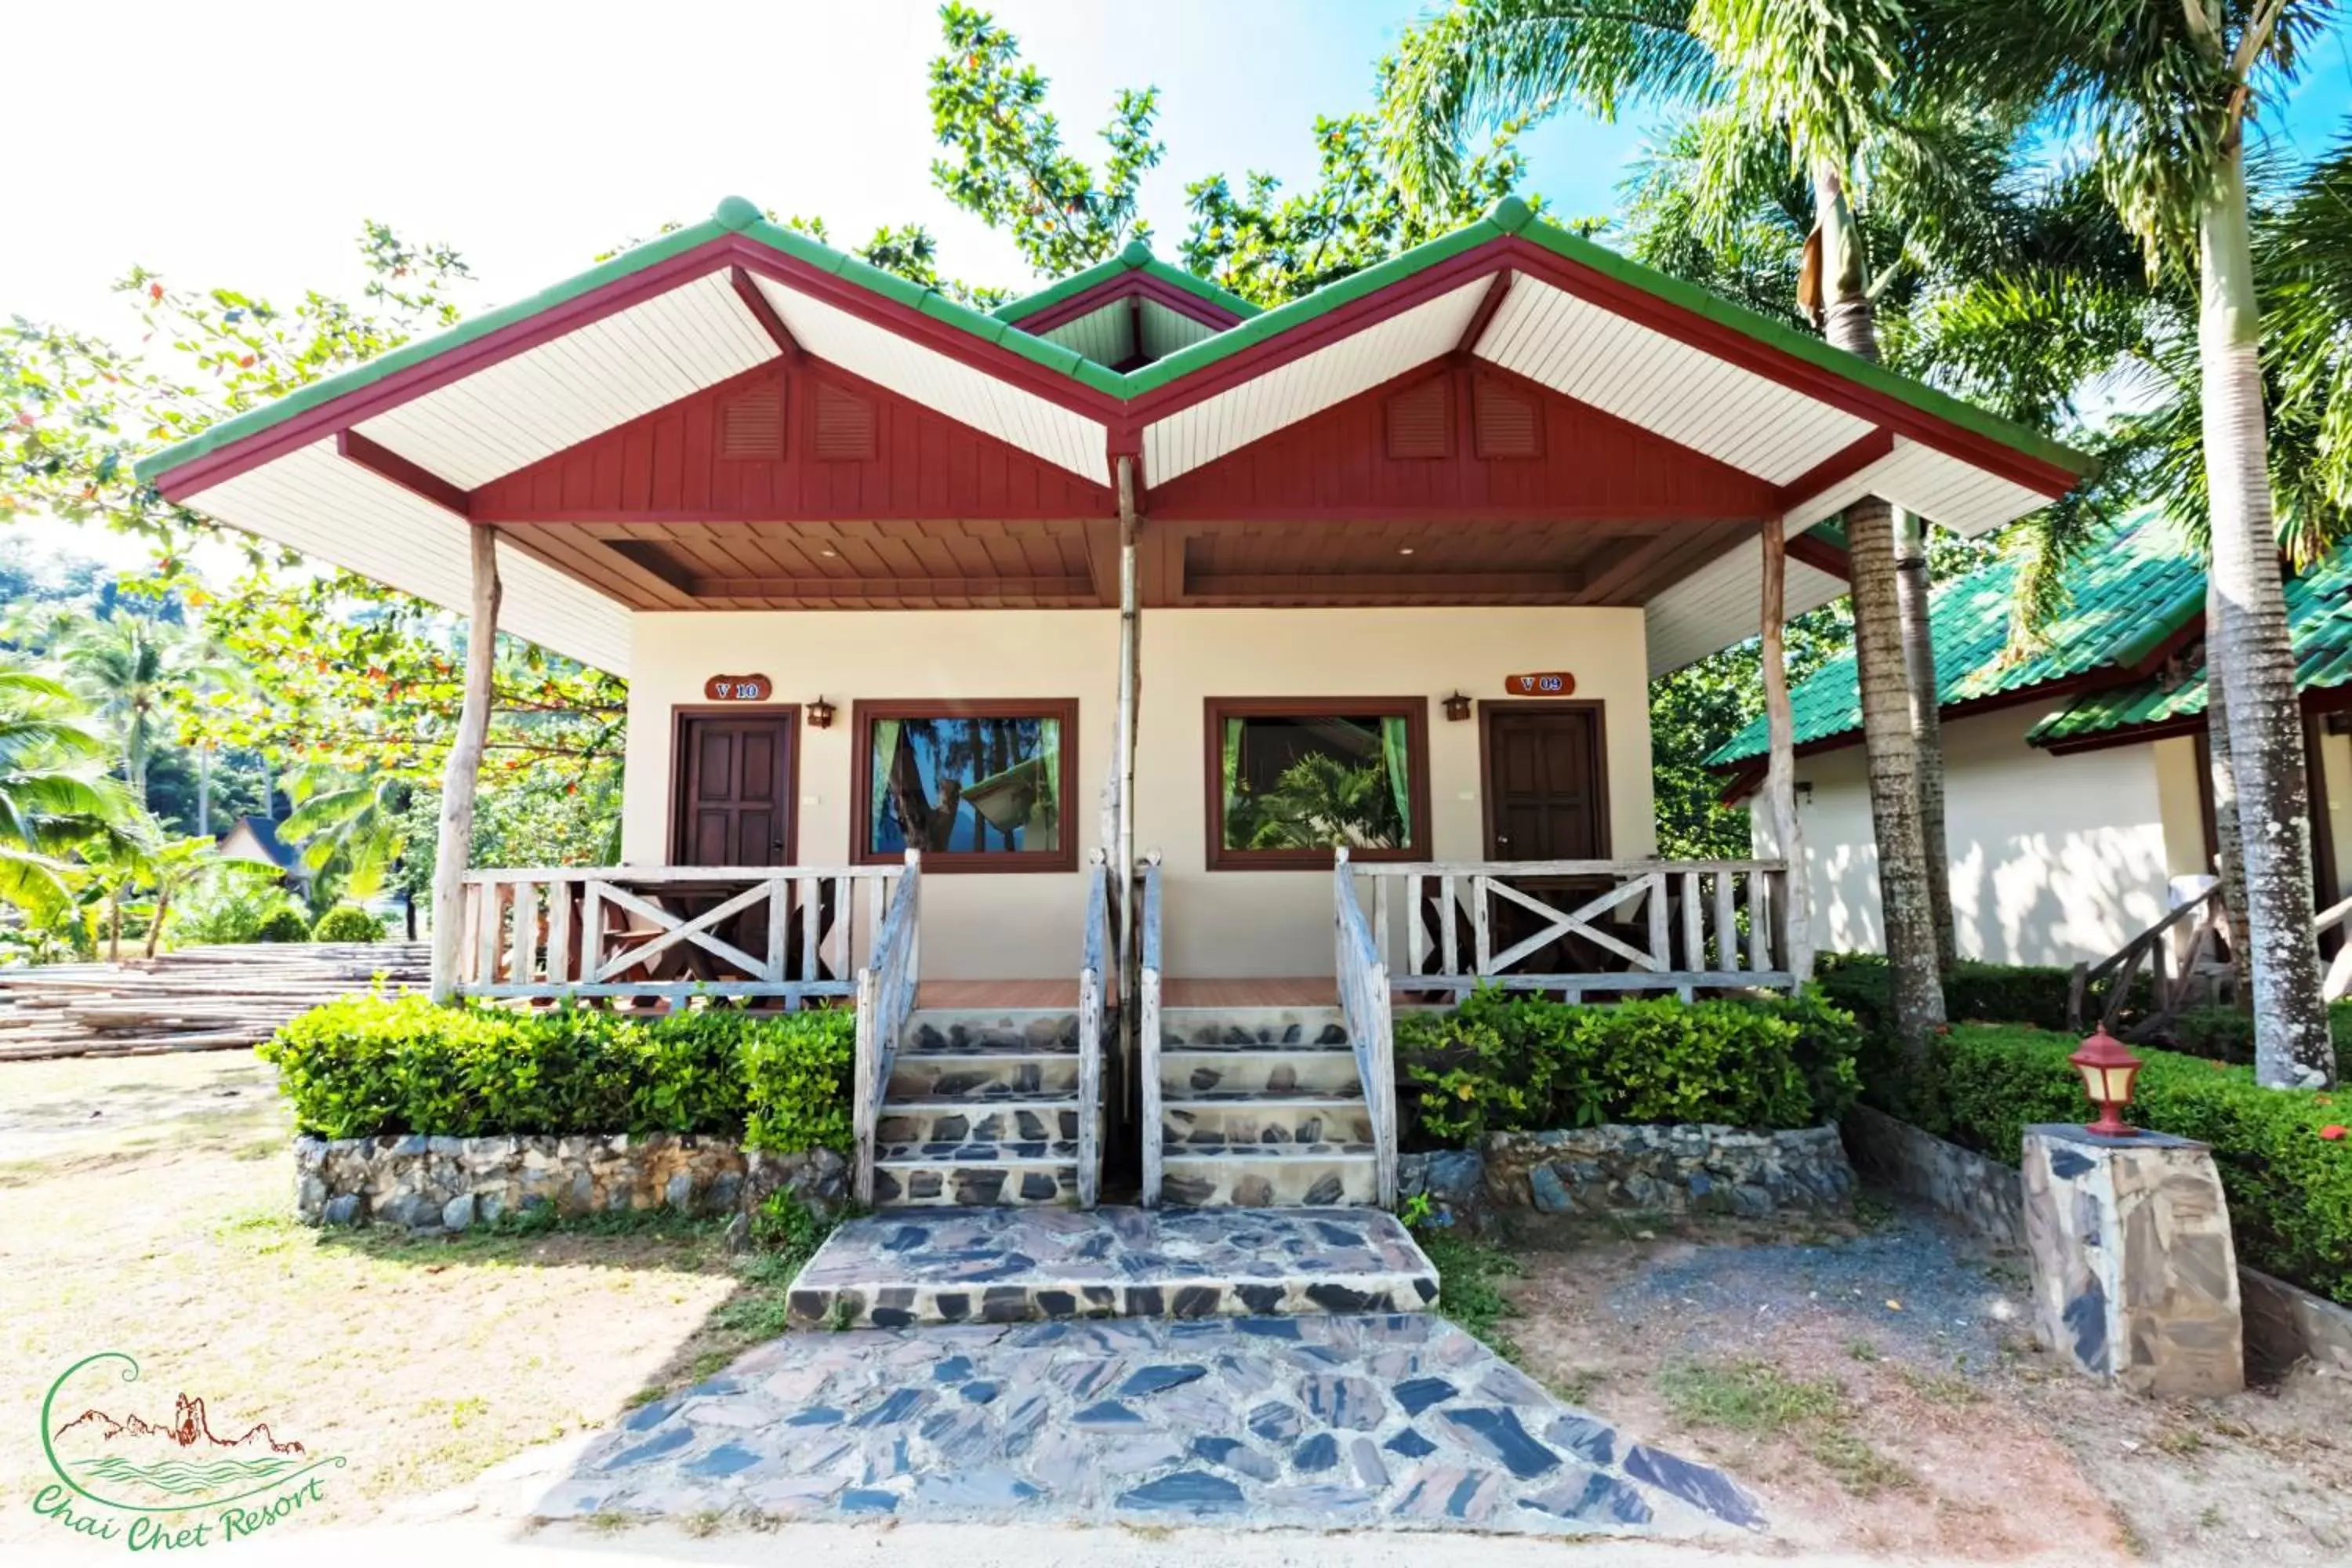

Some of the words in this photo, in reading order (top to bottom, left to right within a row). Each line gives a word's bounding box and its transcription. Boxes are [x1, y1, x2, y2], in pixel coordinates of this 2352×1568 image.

[715, 683, 731, 699] V
[736, 683, 758, 699] 10
[1521, 677, 1535, 691] V
[1539, 676, 1562, 691] 09
